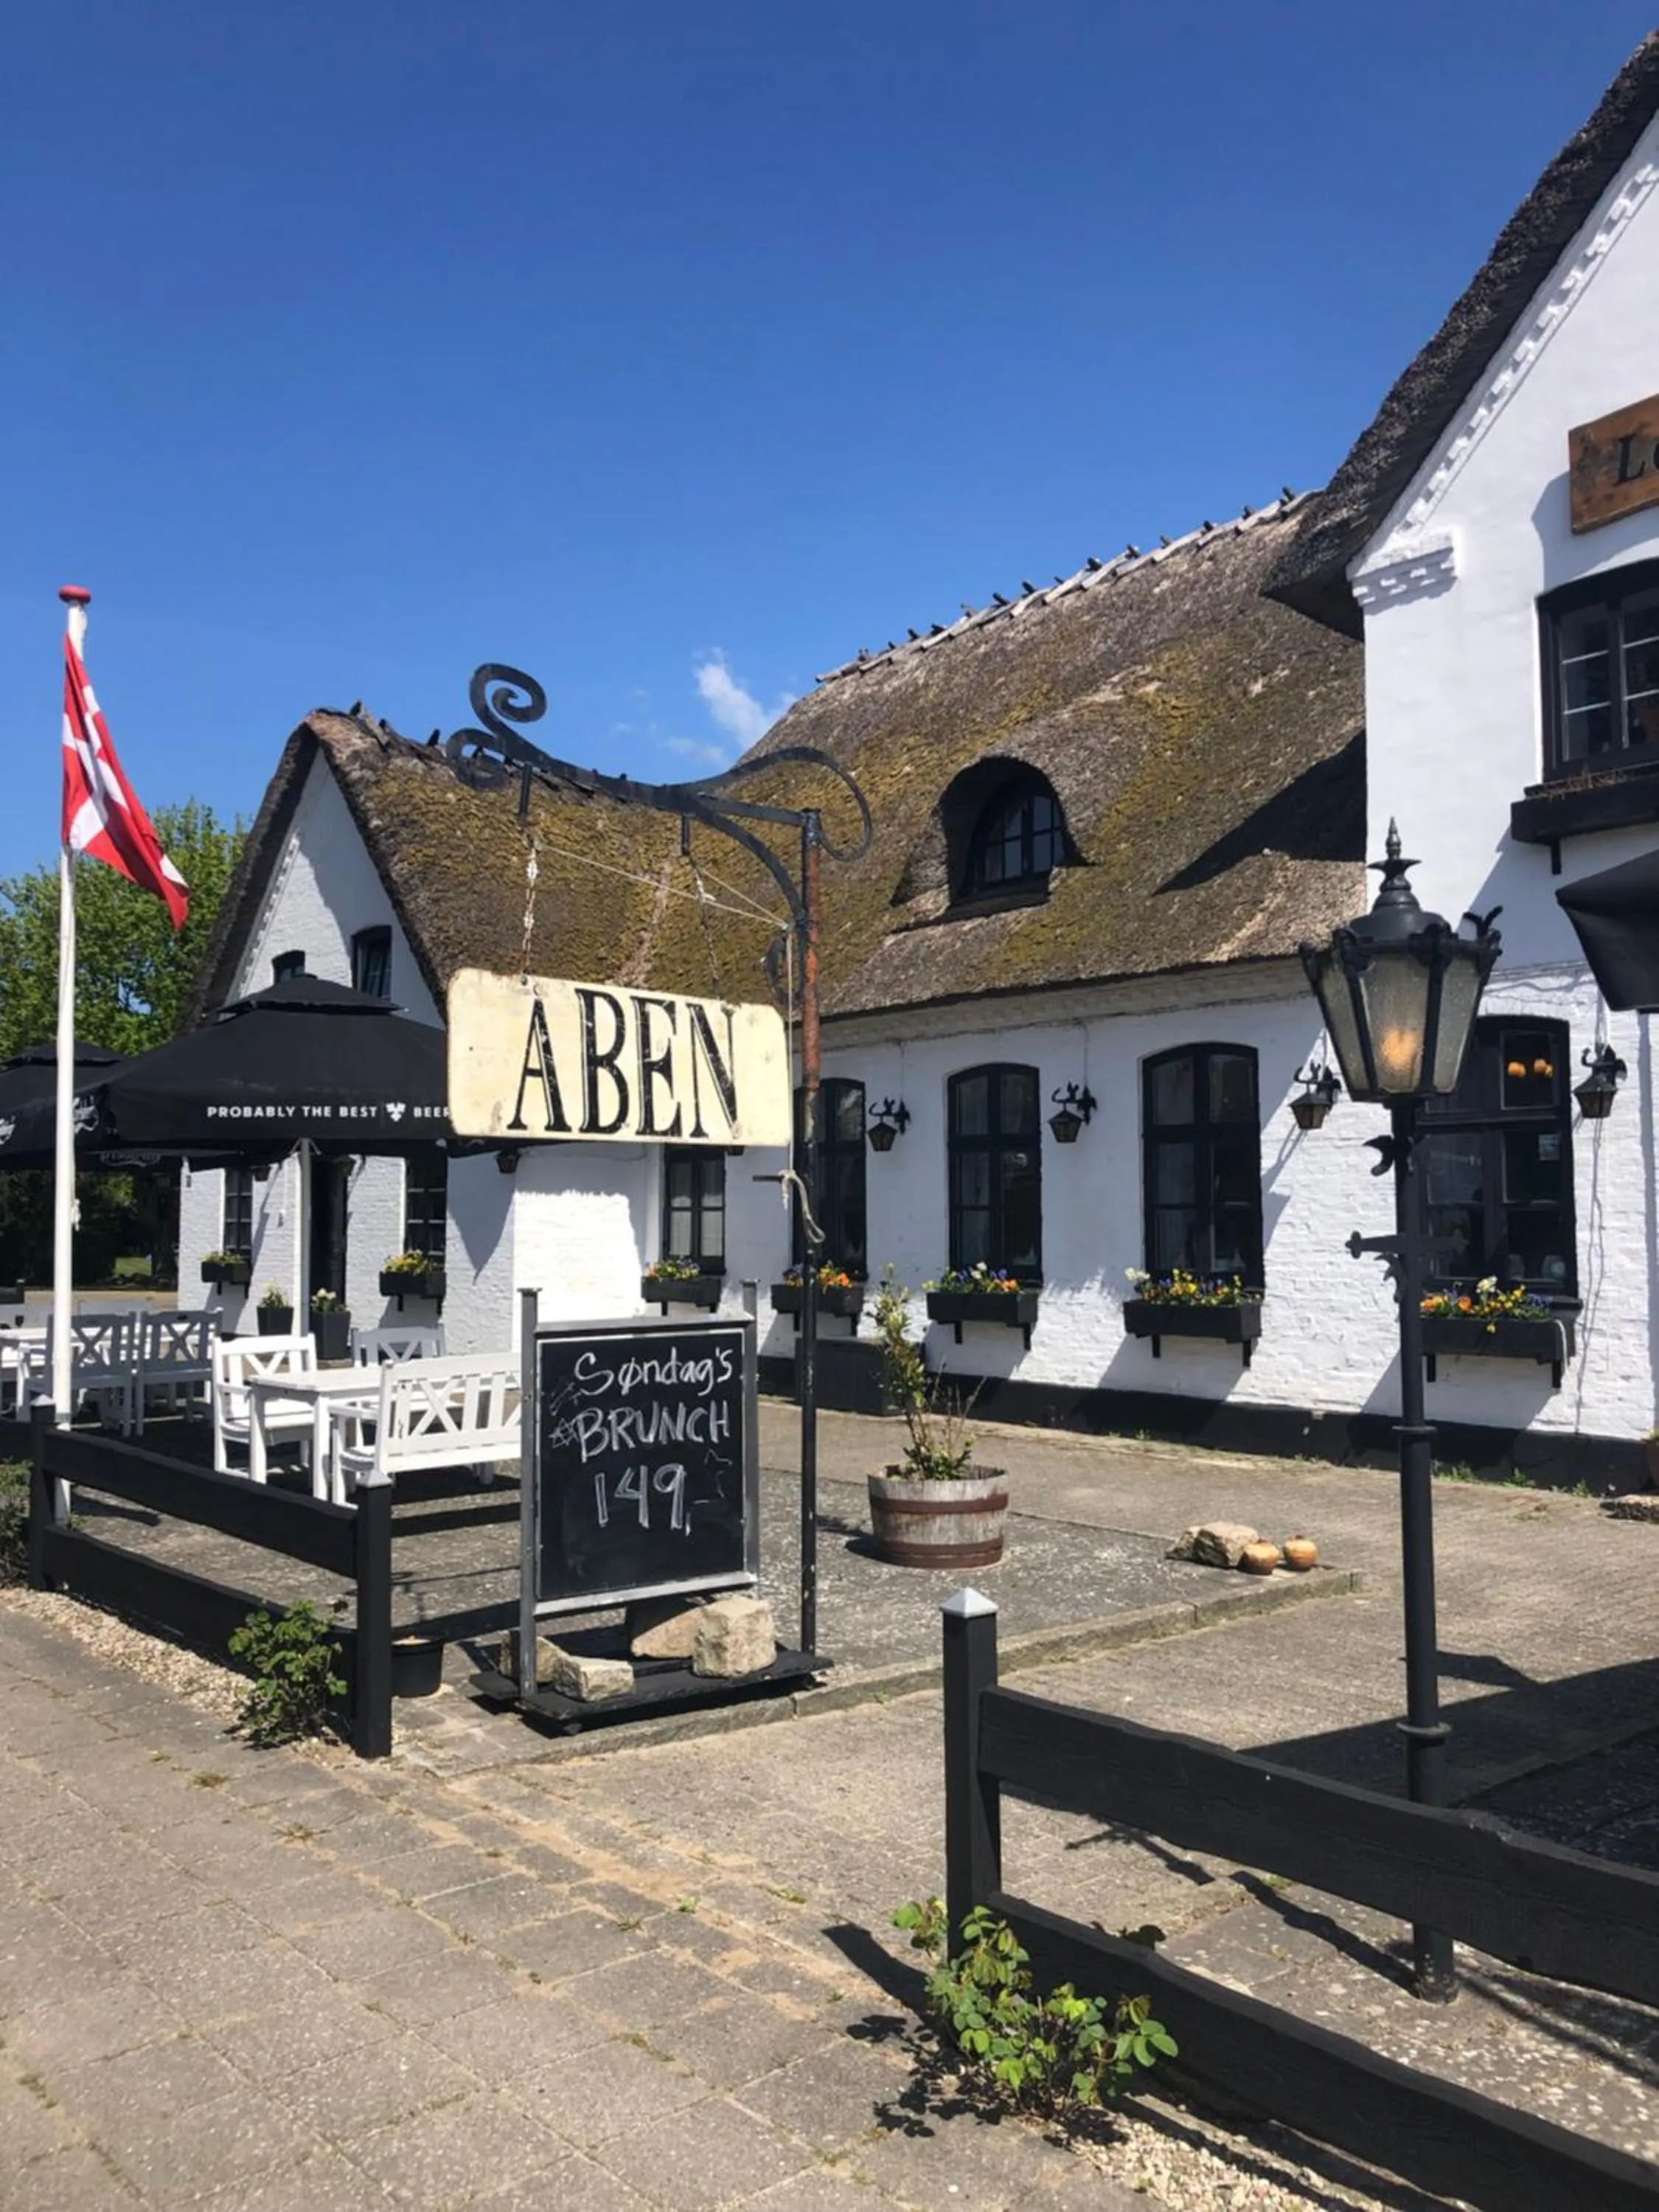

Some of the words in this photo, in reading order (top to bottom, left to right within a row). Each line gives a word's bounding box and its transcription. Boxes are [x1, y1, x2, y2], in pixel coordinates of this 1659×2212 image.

[206, 1105, 296, 1119] PROBABLY
[302, 1106, 332, 1118] THE
[338, 1106, 377, 1118] BEST
[574, 1346, 734, 1397] Søndag's
[572, 1400, 730, 1464] BRUNCH
